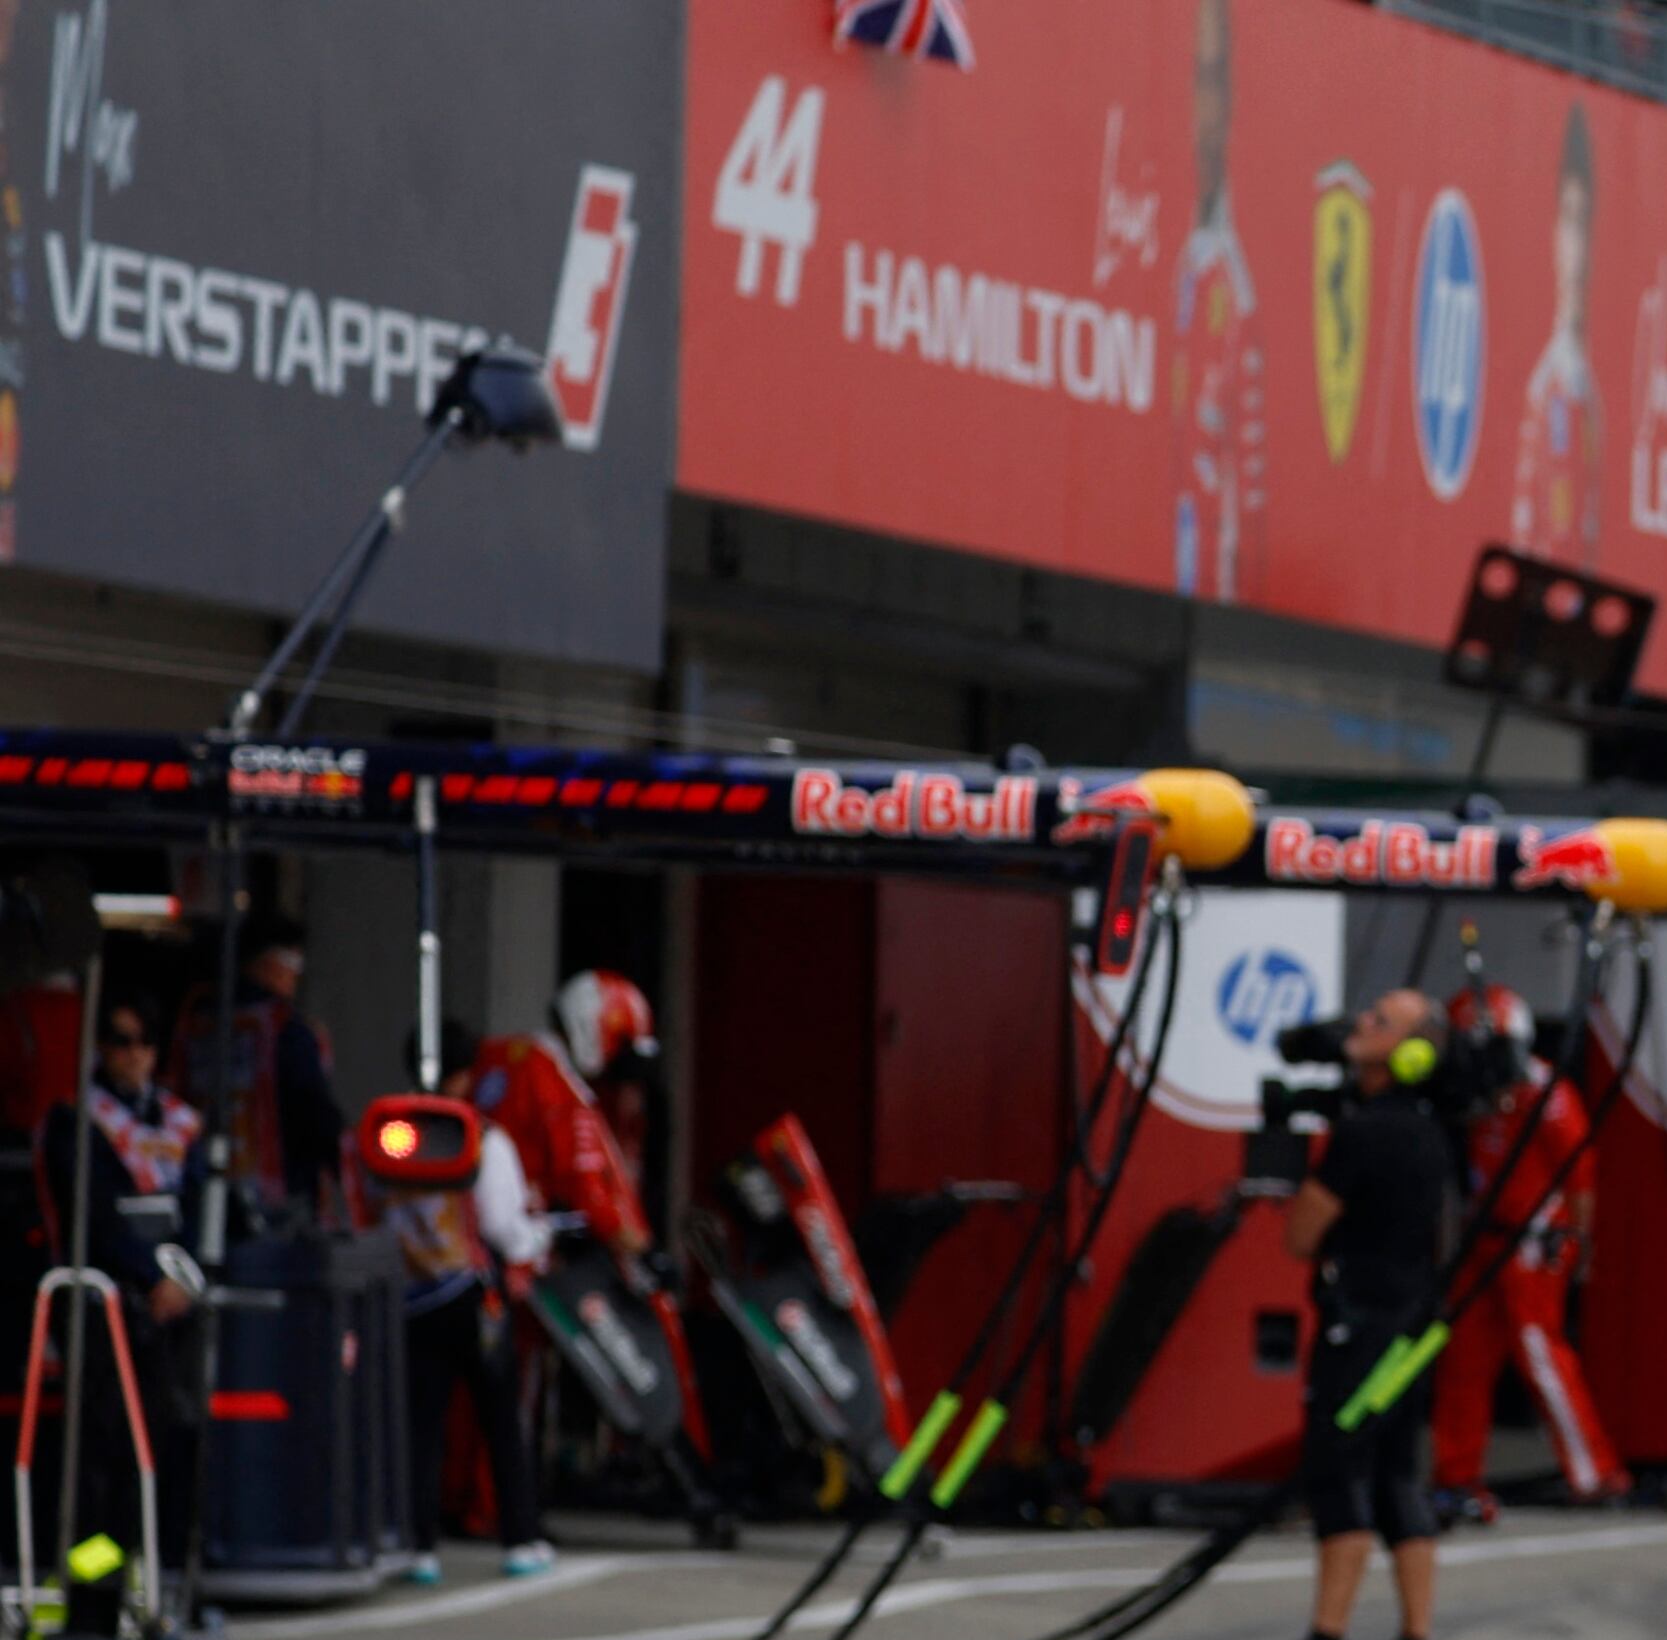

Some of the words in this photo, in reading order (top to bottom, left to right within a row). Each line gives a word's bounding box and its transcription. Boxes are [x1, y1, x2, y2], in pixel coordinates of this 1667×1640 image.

[713, 76, 825, 308] 44
[45, 231, 512, 416] VERSTAPPE
[844, 239, 1155, 414] HAMILTON
[230, 745, 367, 776] ORACLE
[793, 768, 913, 836] Red
[915, 771, 1038, 840] Bull
[1266, 817, 1383, 882] Red
[1385, 821, 1498, 887] Bull
